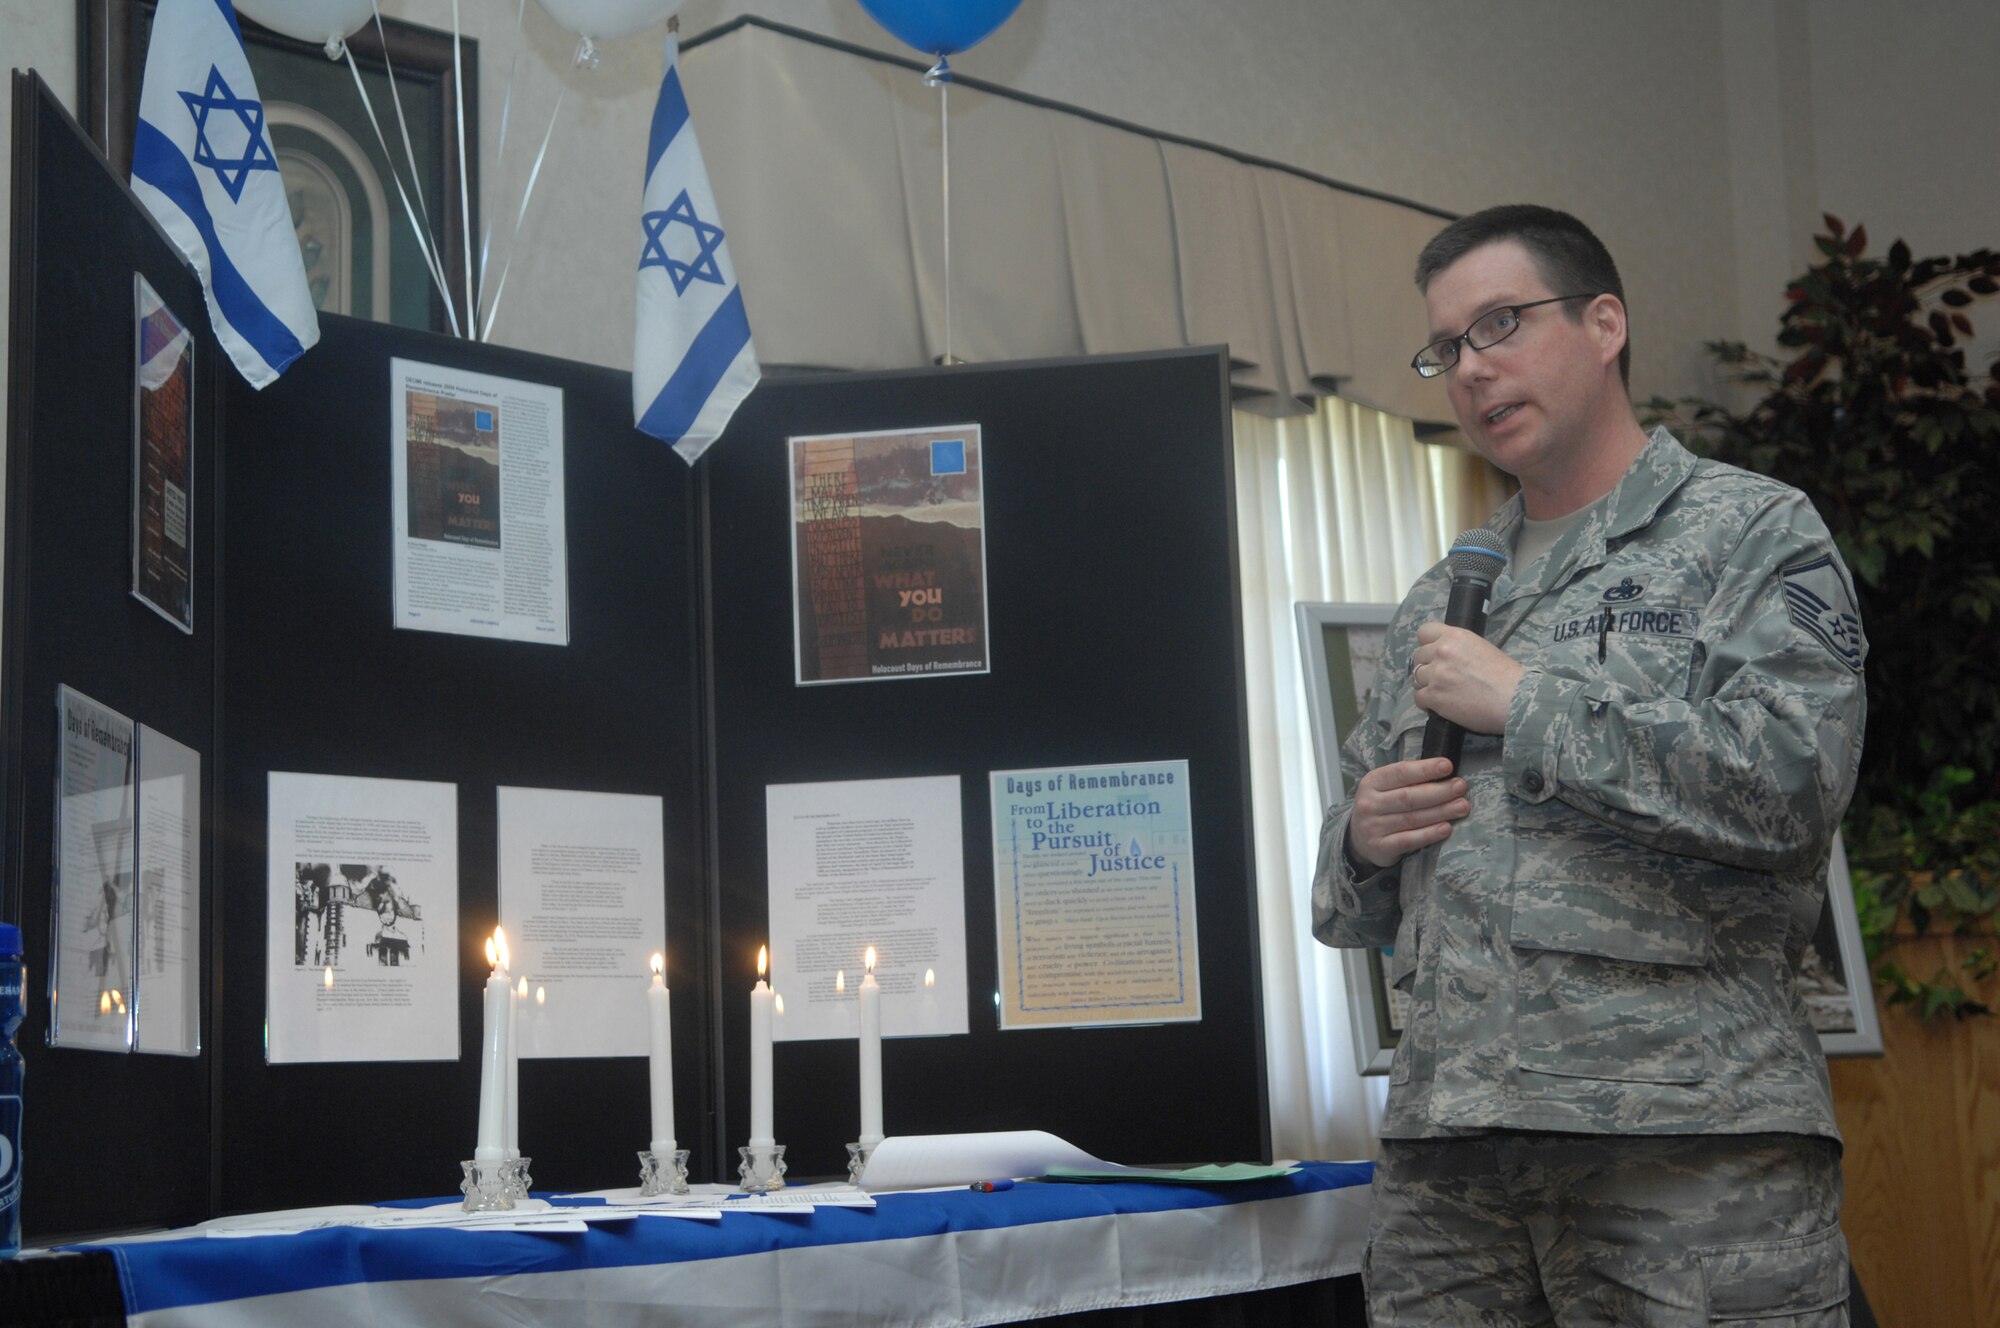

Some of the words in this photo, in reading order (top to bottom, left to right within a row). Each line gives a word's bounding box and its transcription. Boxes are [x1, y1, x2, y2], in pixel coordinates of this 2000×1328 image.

[811, 472, 846, 487] THERE
[458, 493, 480, 505] YOU
[874, 571, 936, 589] WHAT
[899, 588, 943, 607] YOU
[912, 607, 943, 623] DO
[1554, 620, 1580, 642] U.S.
[1619, 611, 1682, 634] FORCE
[872, 664, 905, 674] Holocaust
[907, 663, 923, 673] Days
[925, 661, 932, 670] of
[933, 660, 982, 670] Remembrance
[1007, 776, 1042, 797] Days
[1048, 774, 1063, 791] of
[1069, 771, 1174, 790] Remembrance
[1011, 804, 1045, 815] From
[1047, 800, 1161, 820] Liberation
[1027, 818, 1043, 829] to
[1048, 821, 1075, 834] the
[1032, 831, 1113, 850] Pursuit
[1104, 844, 1120, 857] of
[1088, 853, 1166, 877] Justice
